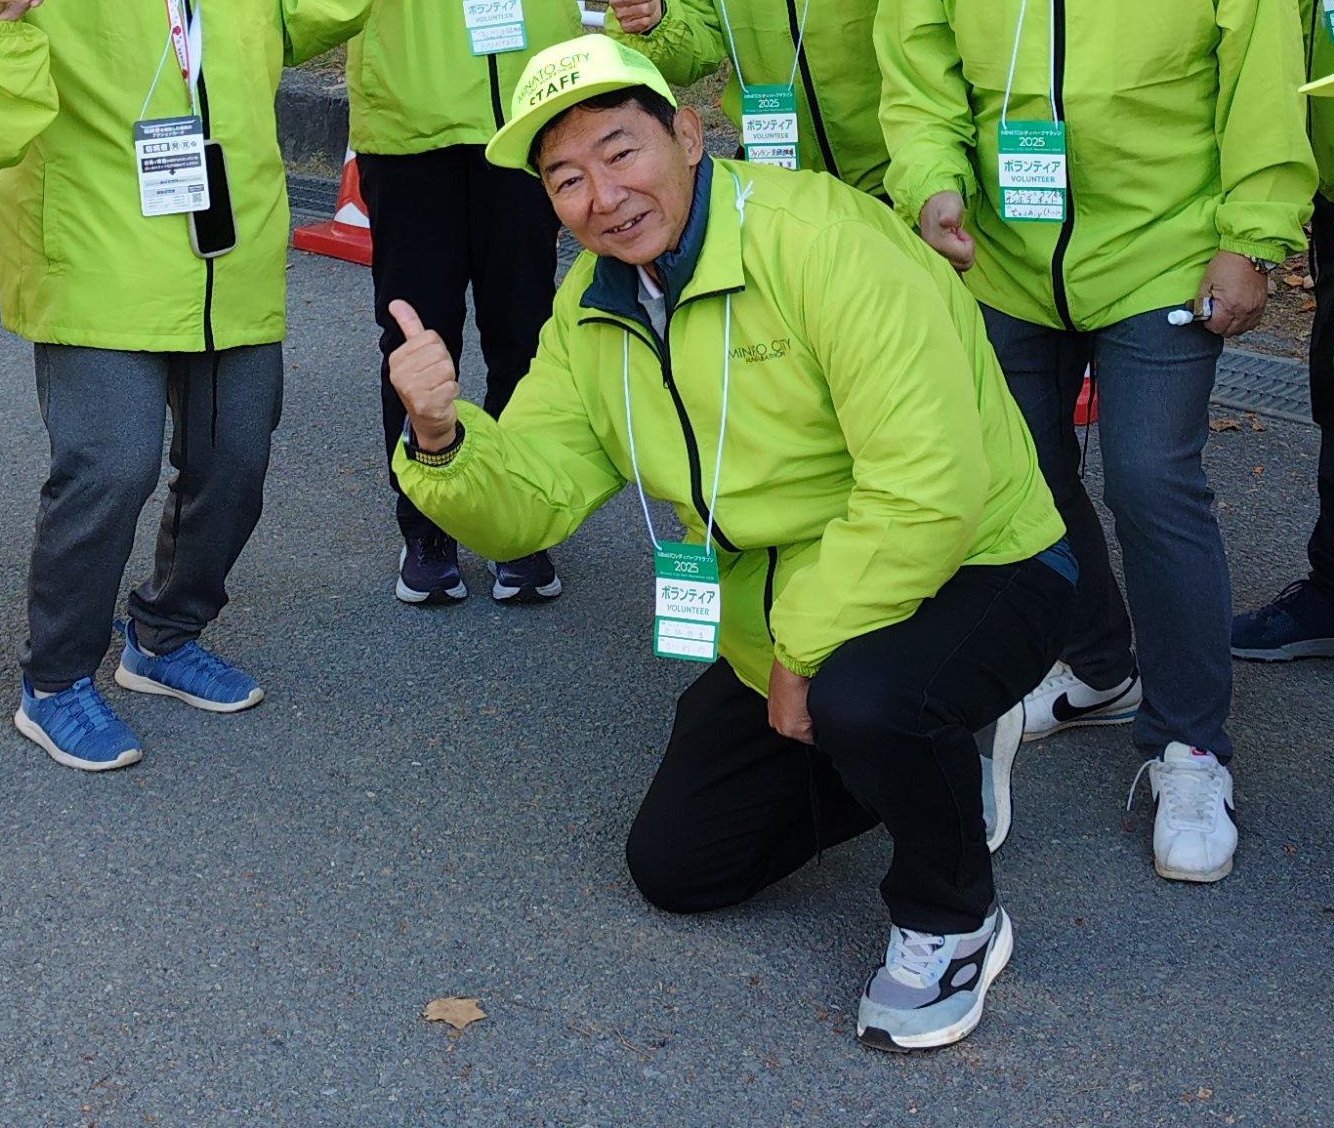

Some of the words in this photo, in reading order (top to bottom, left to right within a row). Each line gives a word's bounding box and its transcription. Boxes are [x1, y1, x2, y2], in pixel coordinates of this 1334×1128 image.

[468, 0, 517, 16] ボランティア
[758, 99, 780, 108] 2025
[747, 119, 793, 131] ボランティア
[1019, 137, 1045, 147] 2025
[1004, 159, 1061, 173] ボランティア
[1011, 175, 1056, 183] VOLUNTEER
[674, 561, 700, 574] 2025
[661, 585, 716, 605] ボランティア
[666, 603, 710, 617] VOLUNTEER
